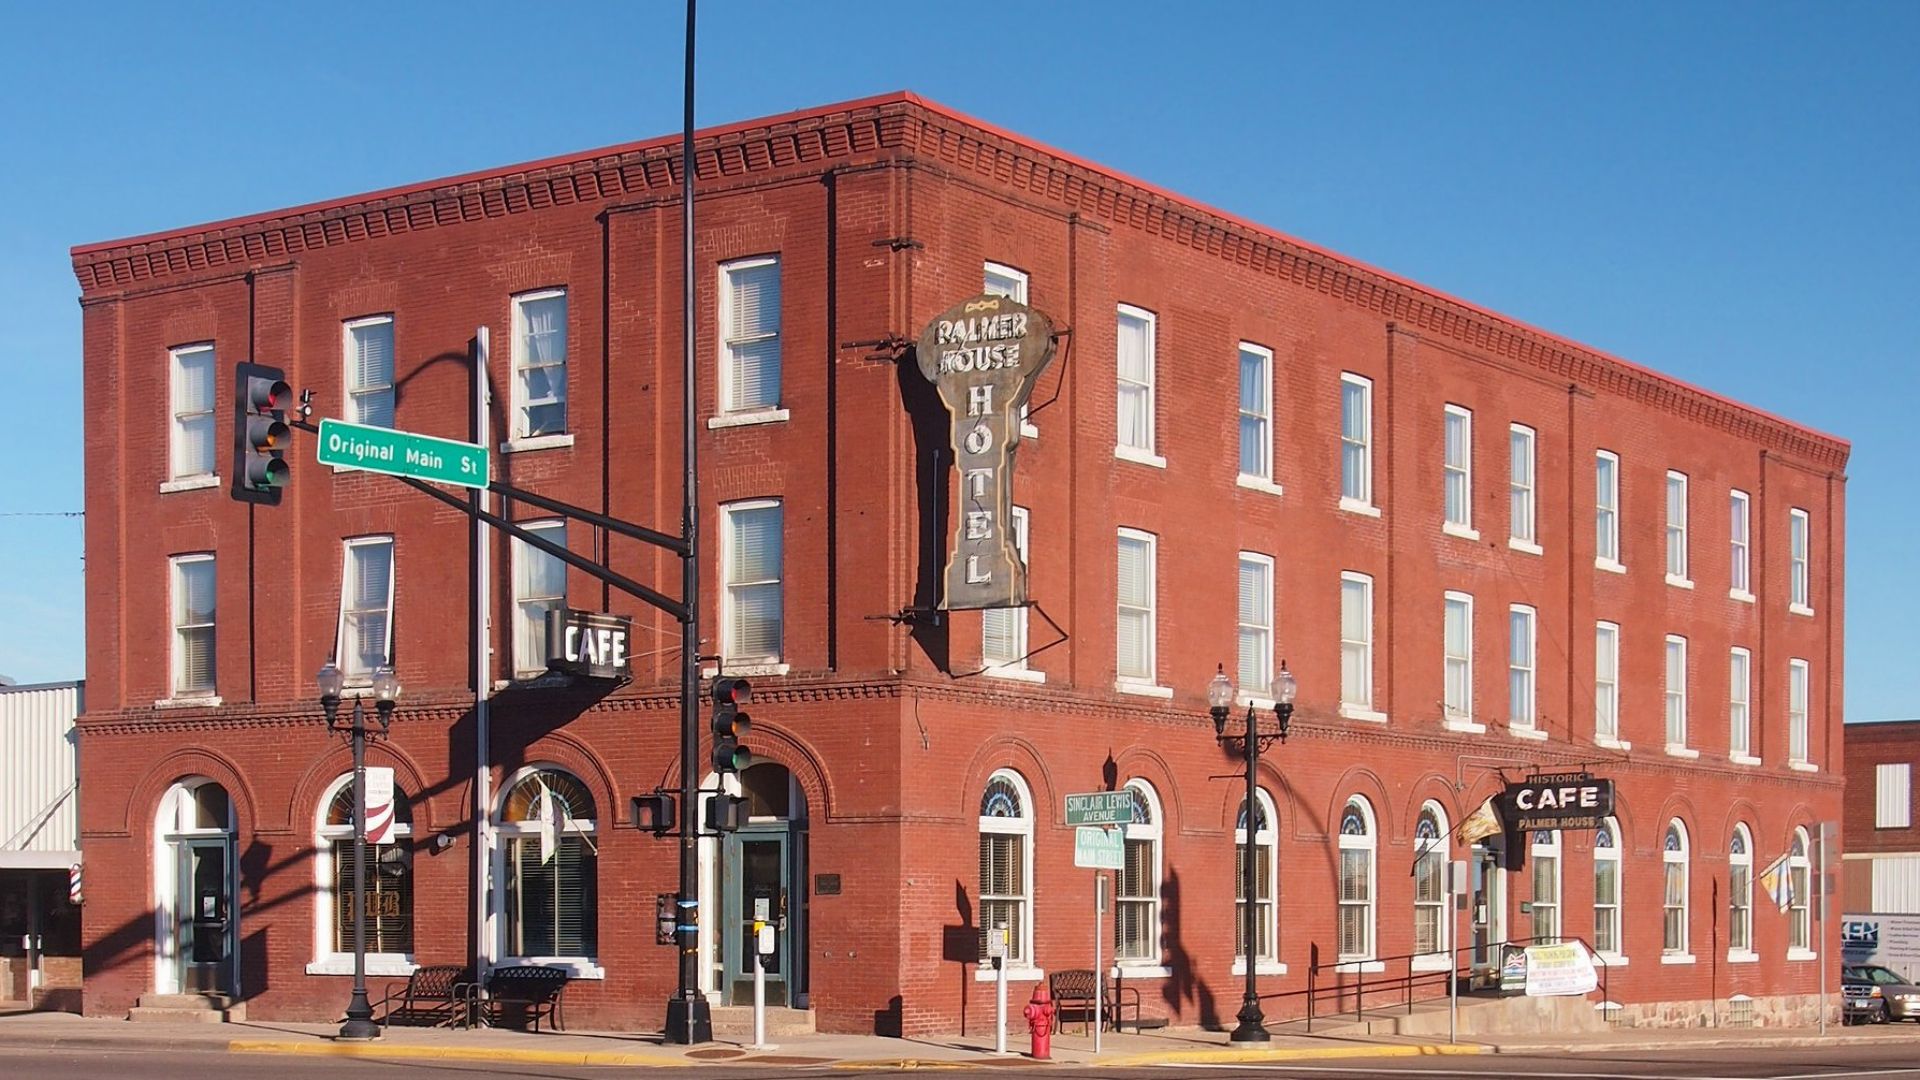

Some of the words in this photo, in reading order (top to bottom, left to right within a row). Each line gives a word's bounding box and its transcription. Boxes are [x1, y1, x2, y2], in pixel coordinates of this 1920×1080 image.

[937, 312, 1028, 345] PALMER
[938, 344, 1020, 373] HOUSE
[329, 434, 394, 461] Original
[406, 448, 443, 469] Main
[461, 456, 478, 475] St
[965, 385, 993, 585] HOTEL
[565, 626, 626, 667] CAFE
[1528, 773, 1585, 784] HISTORIC
[1068, 796, 1103, 811] SINCLAIR
[1106, 794, 1130, 809] LEWIS
[1516, 786, 1600, 810] CAFE
[1083, 810, 1116, 821] AVENUE
[1518, 818, 1557, 828] PALMER
[1560, 817, 1595, 827] HOUSE
[1080, 831, 1120, 848] ORIGINAL
